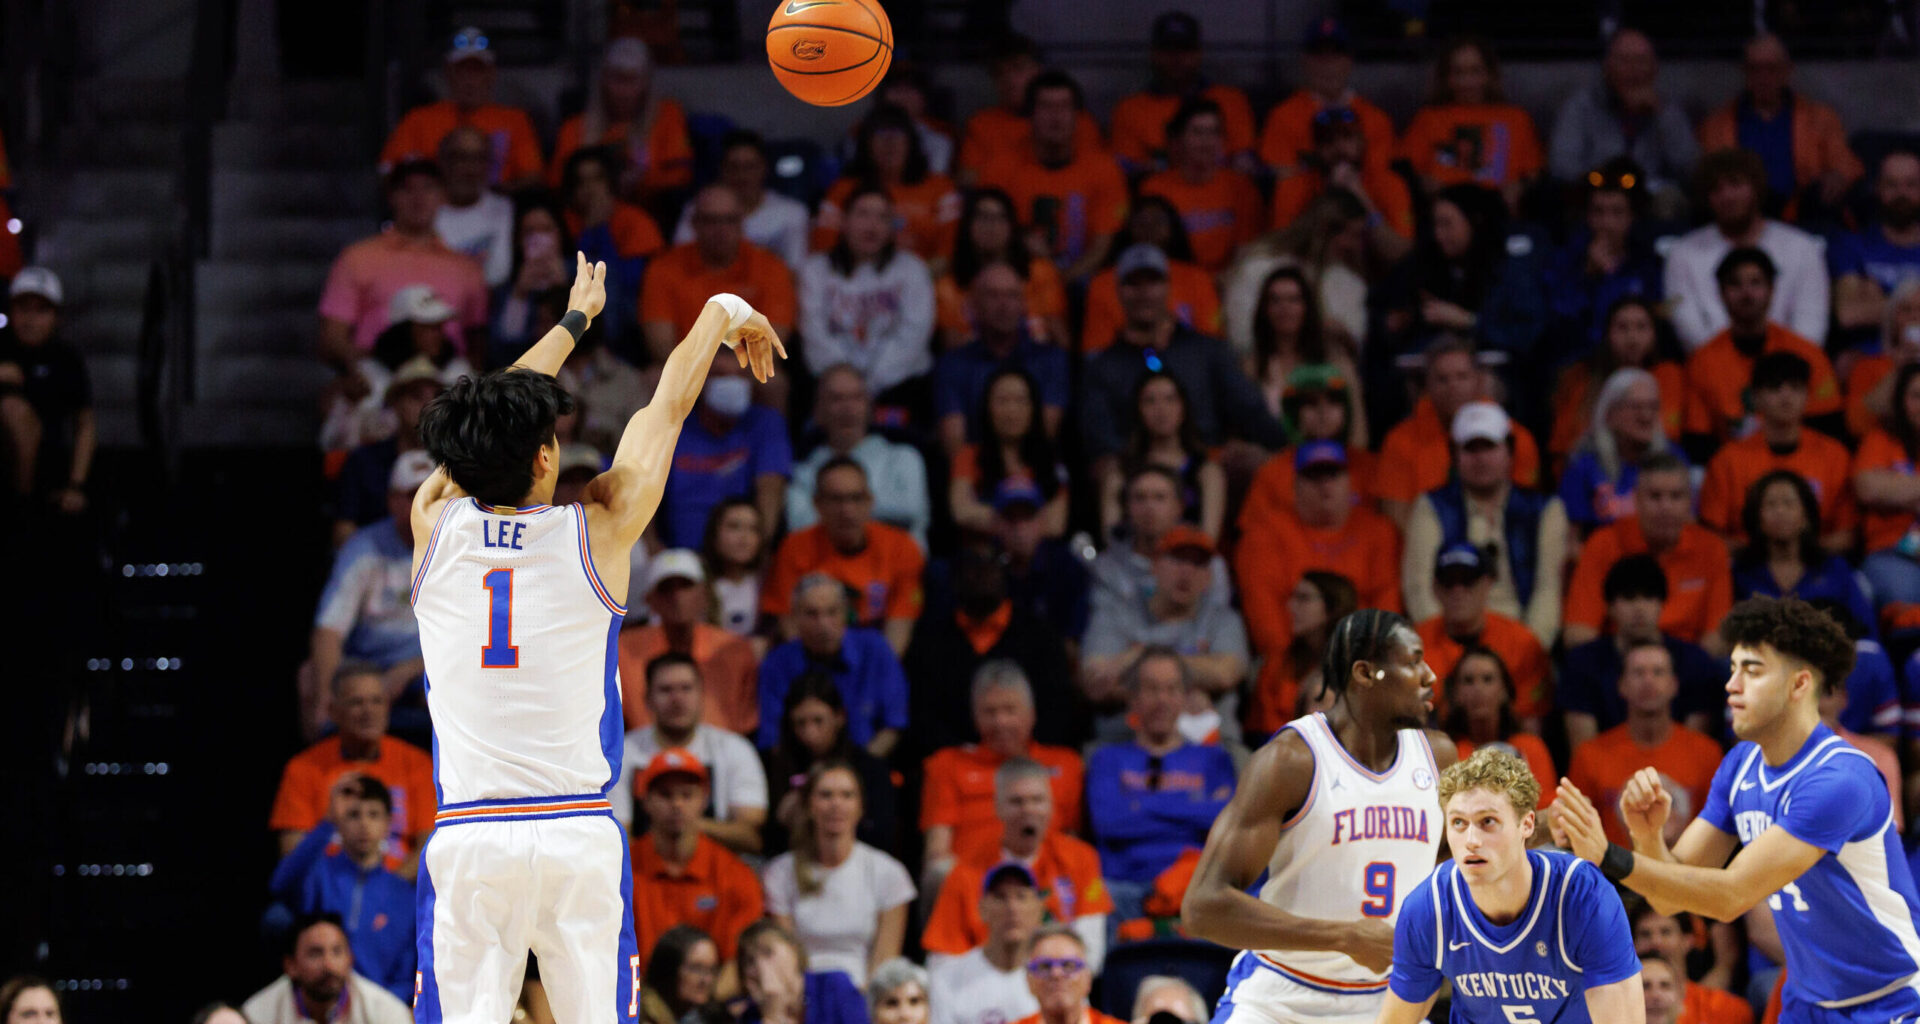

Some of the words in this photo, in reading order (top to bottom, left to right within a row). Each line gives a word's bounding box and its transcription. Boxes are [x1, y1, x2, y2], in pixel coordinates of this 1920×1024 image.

[483, 519, 527, 550] LEE
[481, 568, 519, 668] 1
[1331, 806, 1430, 846] FLORIDA
[1361, 861, 1396, 918] 9
[1455, 971, 1570, 1000] KENTUCKY
